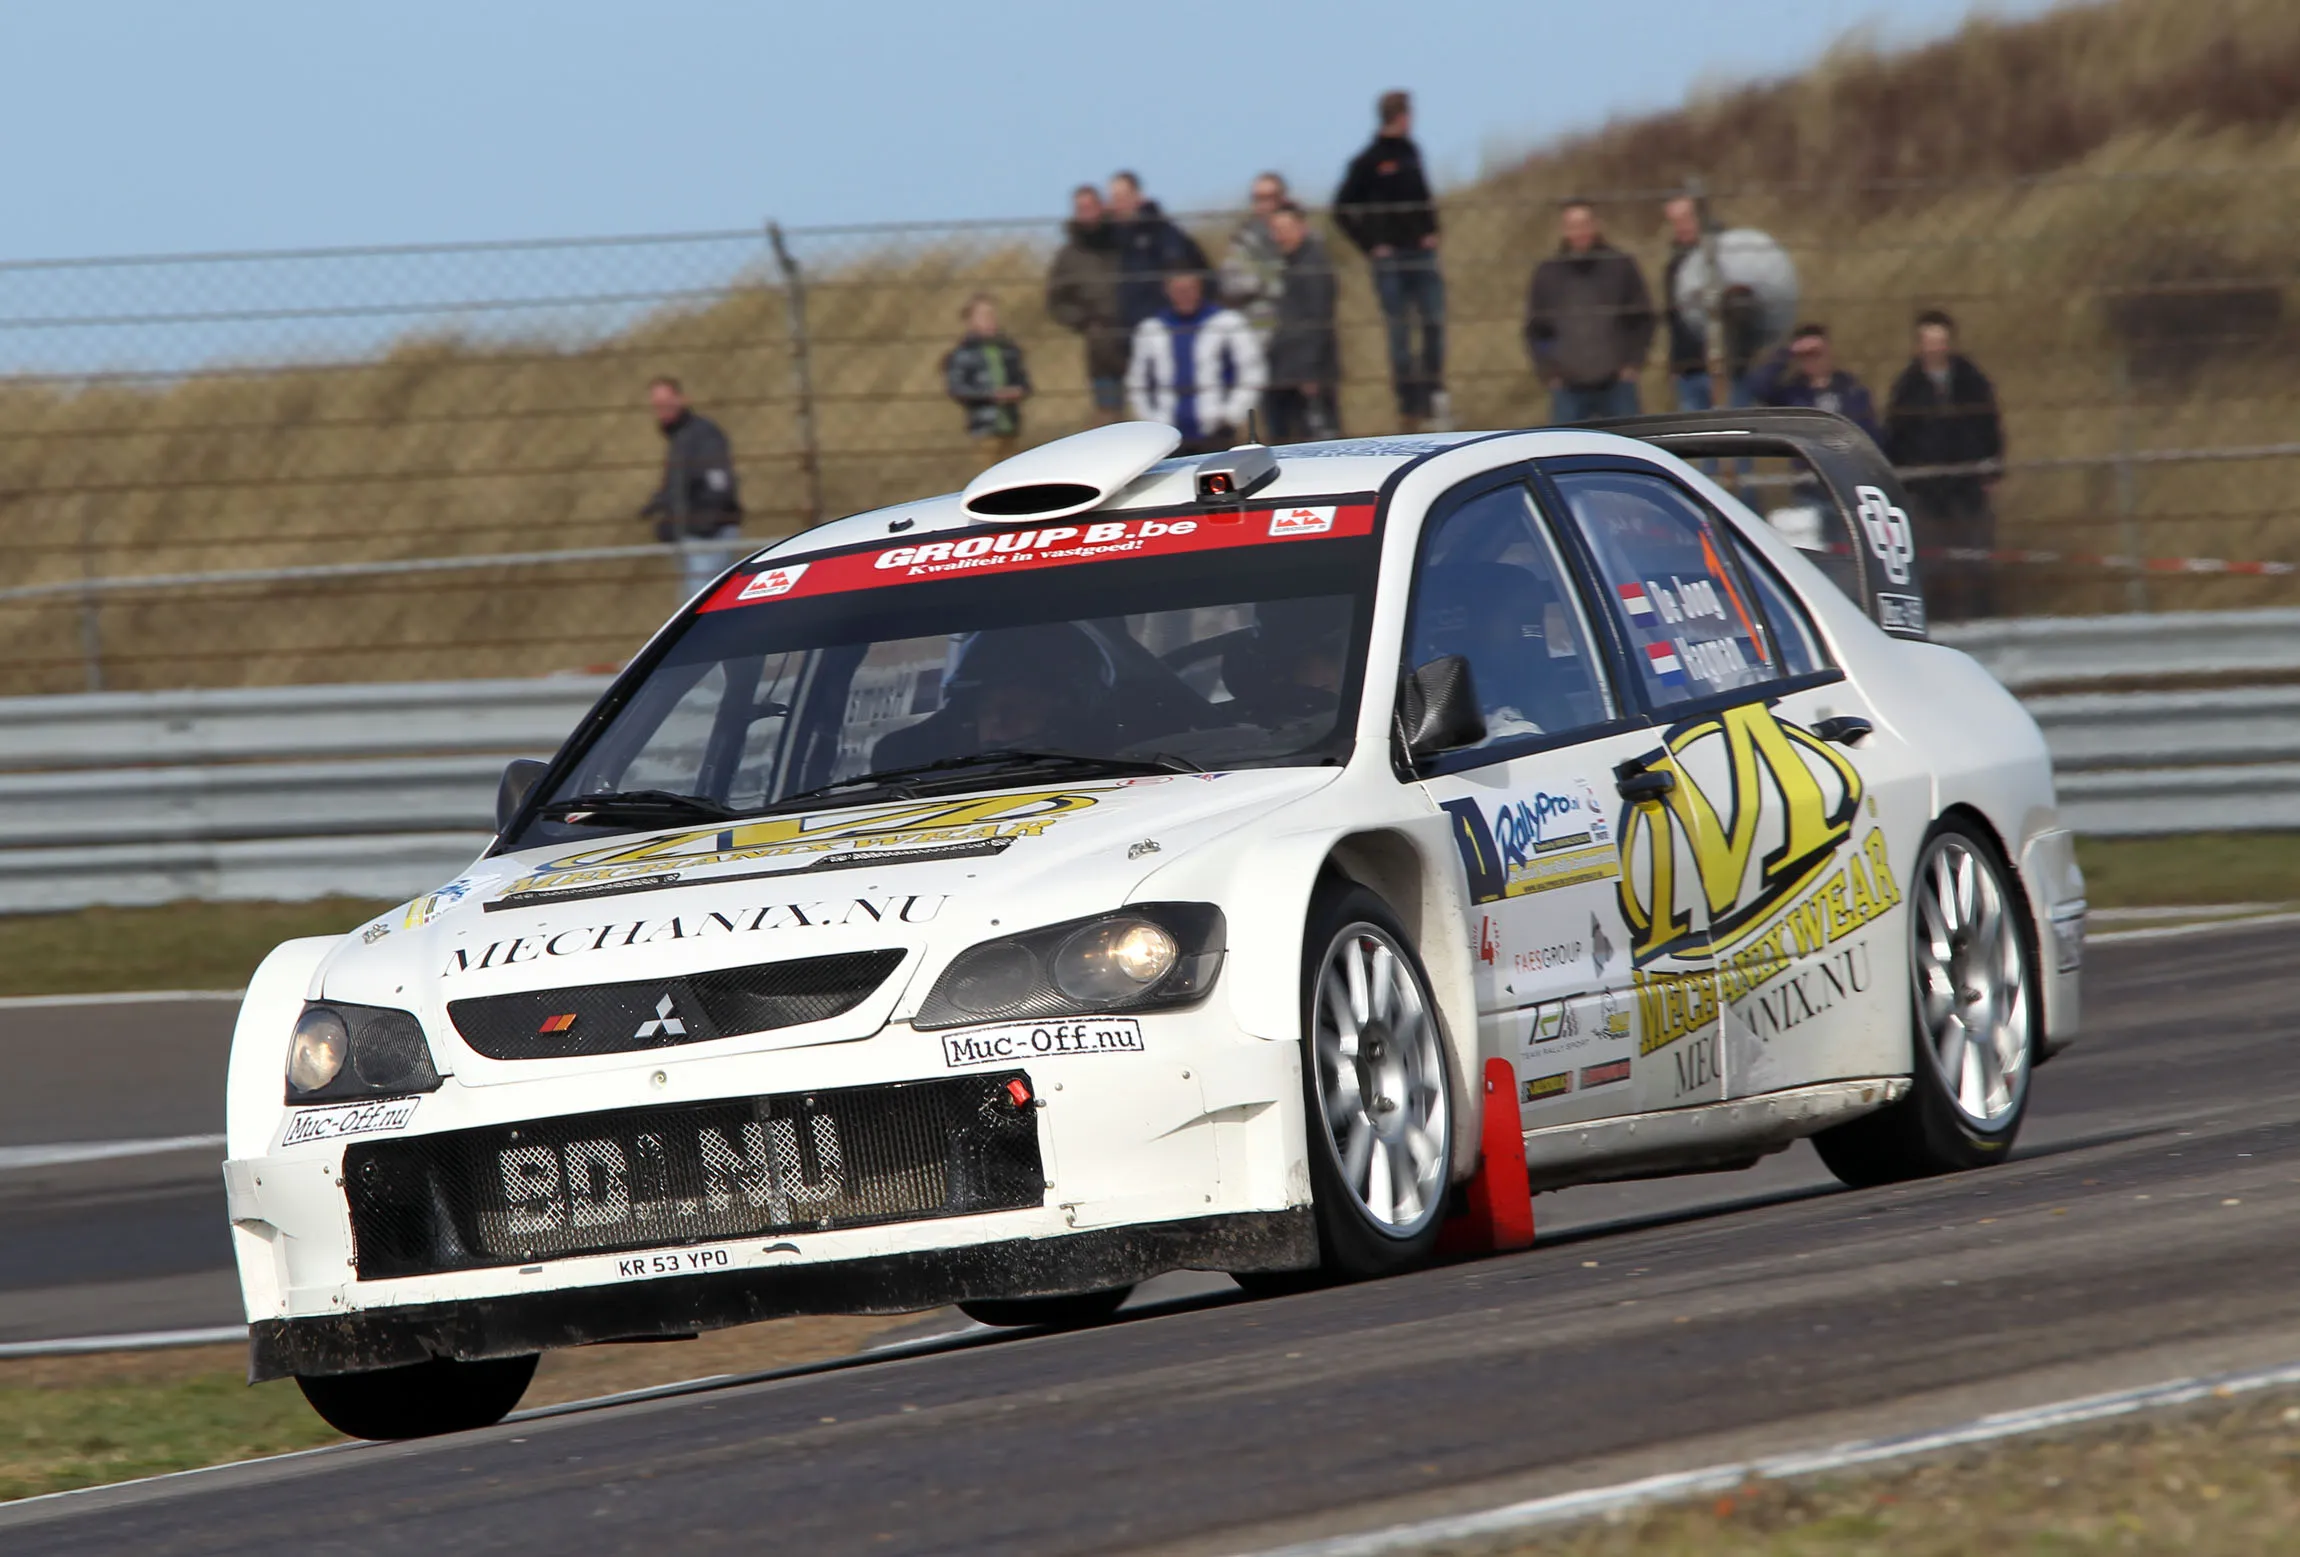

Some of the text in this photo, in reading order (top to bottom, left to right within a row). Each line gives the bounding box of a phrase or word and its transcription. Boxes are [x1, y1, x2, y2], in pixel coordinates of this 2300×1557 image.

[873, 519, 1198, 570] GROUP B.be
[907, 539, 1144, 577] Kwaliteit in vastgoed!
[496, 818, 1057, 897] MECHANIX WEAR
[439, 894, 951, 980] MECHANIX.NU
[1631, 825, 1904, 1059] MECHANIX WEAR
[949, 1024, 1137, 1063] Muc-Off.nu
[1674, 940, 1871, 1099] MECNIX.NU
[287, 1104, 410, 1142] Muc-Off.nu
[619, 1249, 729, 1277] KR 53 YPO
